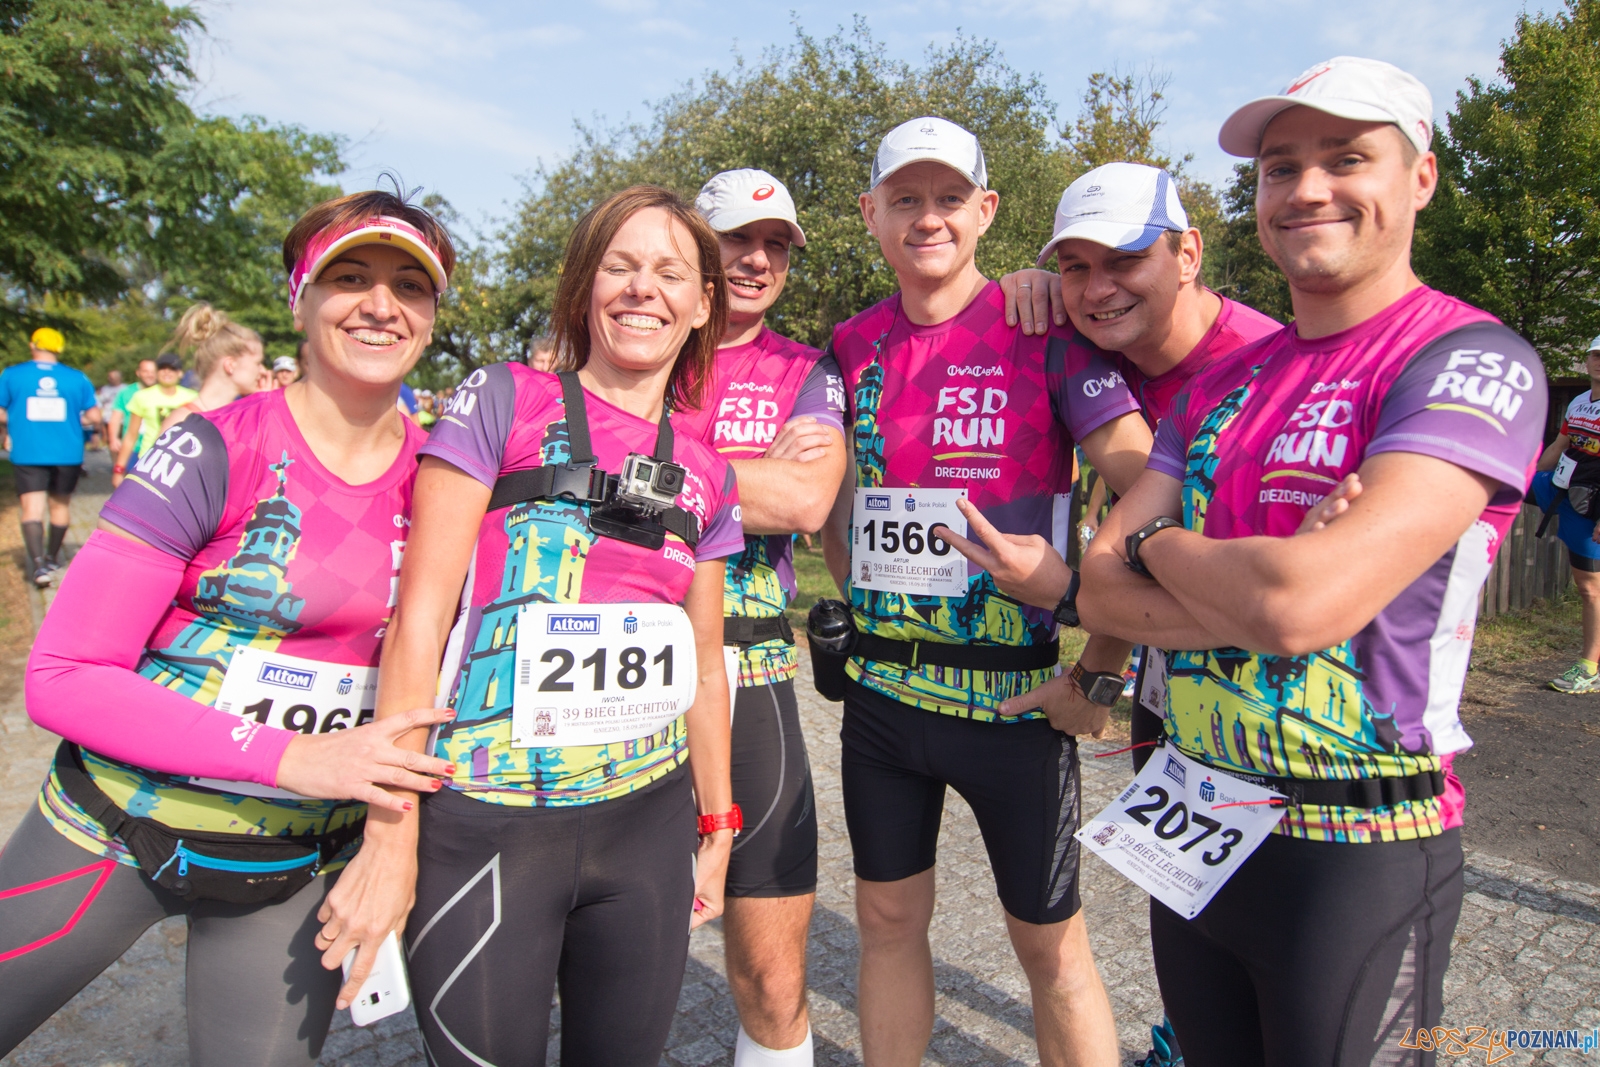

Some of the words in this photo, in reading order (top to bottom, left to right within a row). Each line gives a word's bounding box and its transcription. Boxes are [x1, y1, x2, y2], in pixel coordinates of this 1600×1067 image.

[826, 374, 844, 392] FS
[1444, 349, 1534, 392] FSD
[718, 396, 779, 419] FSD
[826, 387, 846, 411] RU
[936, 386, 1008, 414] FSD
[1427, 371, 1523, 422] RUN
[1284, 399, 1352, 428] FSD
[714, 420, 776, 444] RUN
[932, 417, 1006, 448] RUN
[1264, 430, 1349, 468] RUN
[134, 448, 185, 488] UN
[934, 466, 1001, 480] DREZDENKO
[863, 520, 951, 556] 1566
[874, 563, 882, 572] 39
[885, 564, 903, 574] BIEG
[906, 566, 954, 577] LECHITÓW
[538, 645, 673, 692] 2181
[562, 708, 580, 720] 39
[585, 706, 616, 718] BIEG
[620, 698, 680, 716] LECHITÓW
[1124, 786, 1243, 867] 2073
[1120, 834, 1135, 846] 39
[1133, 843, 1159, 862] BIEG
[1153, 843, 1176, 859] TOMASZ
